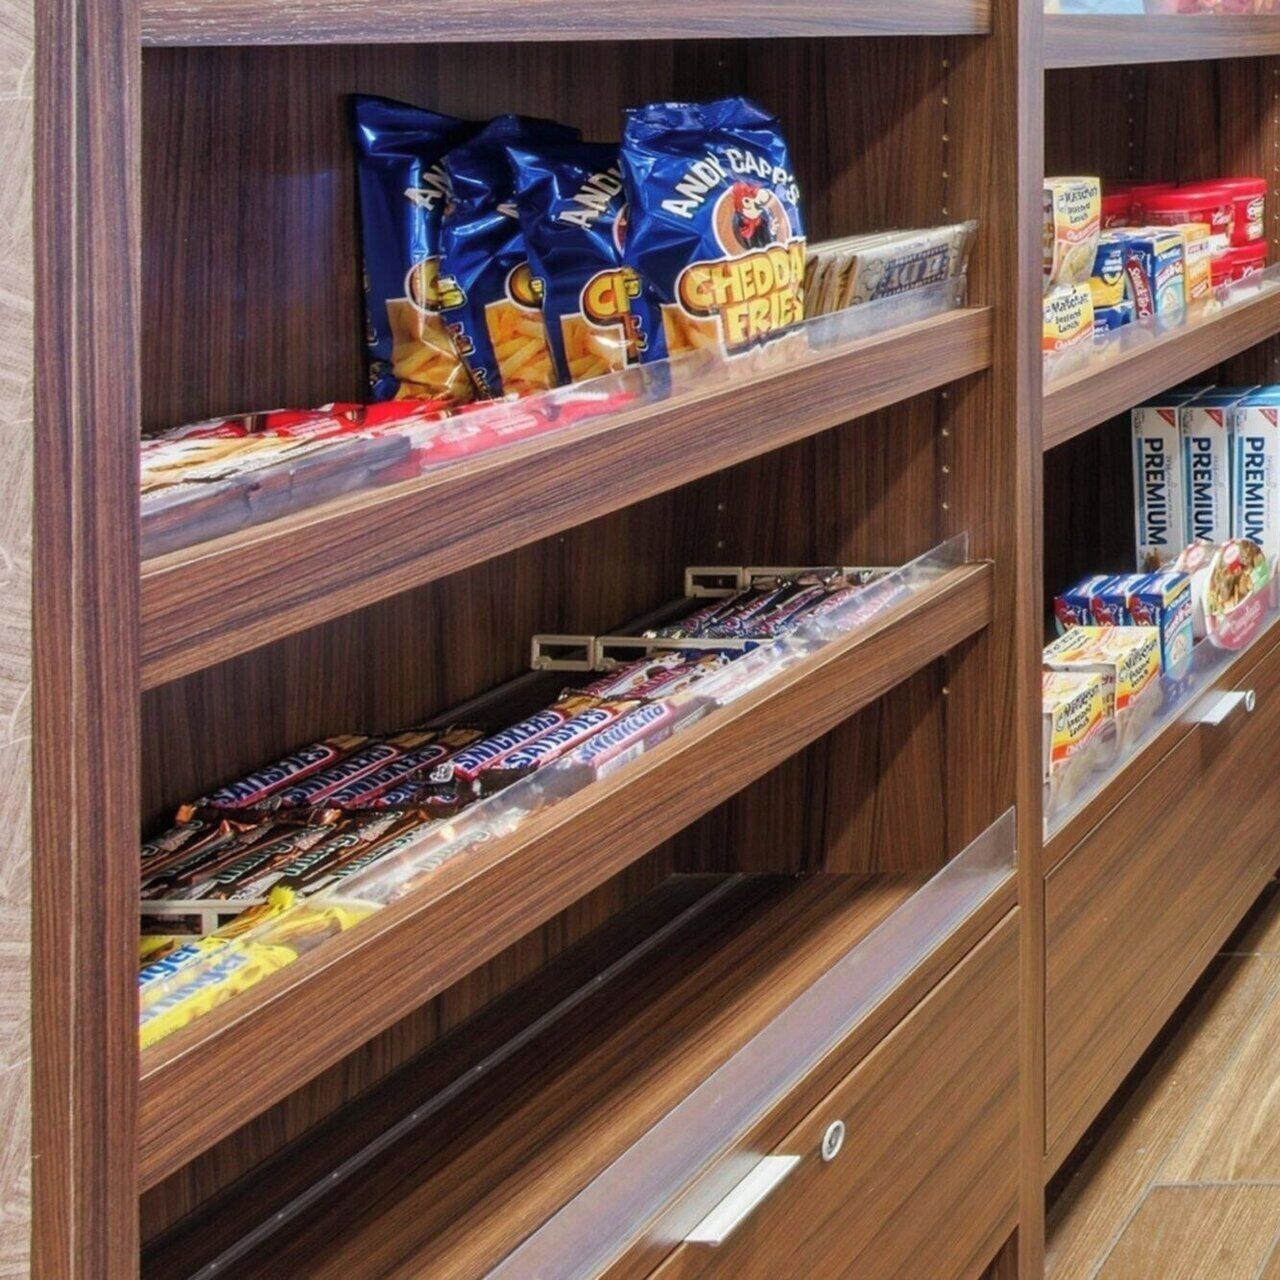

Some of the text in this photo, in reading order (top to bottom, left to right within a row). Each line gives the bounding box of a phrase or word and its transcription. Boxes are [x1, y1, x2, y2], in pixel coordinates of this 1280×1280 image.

[660, 147, 800, 219] ANDY CAPP'S
[685, 243, 806, 308] CHEDDA
[1144, 437, 1168, 546] PREMIUM
[1192, 437, 1214, 543] PREMIUM
[1245, 437, 1265, 545] PREMIUM
[455, 709, 562, 772] SNICKERS
[503, 707, 610, 771] SATISFIES
